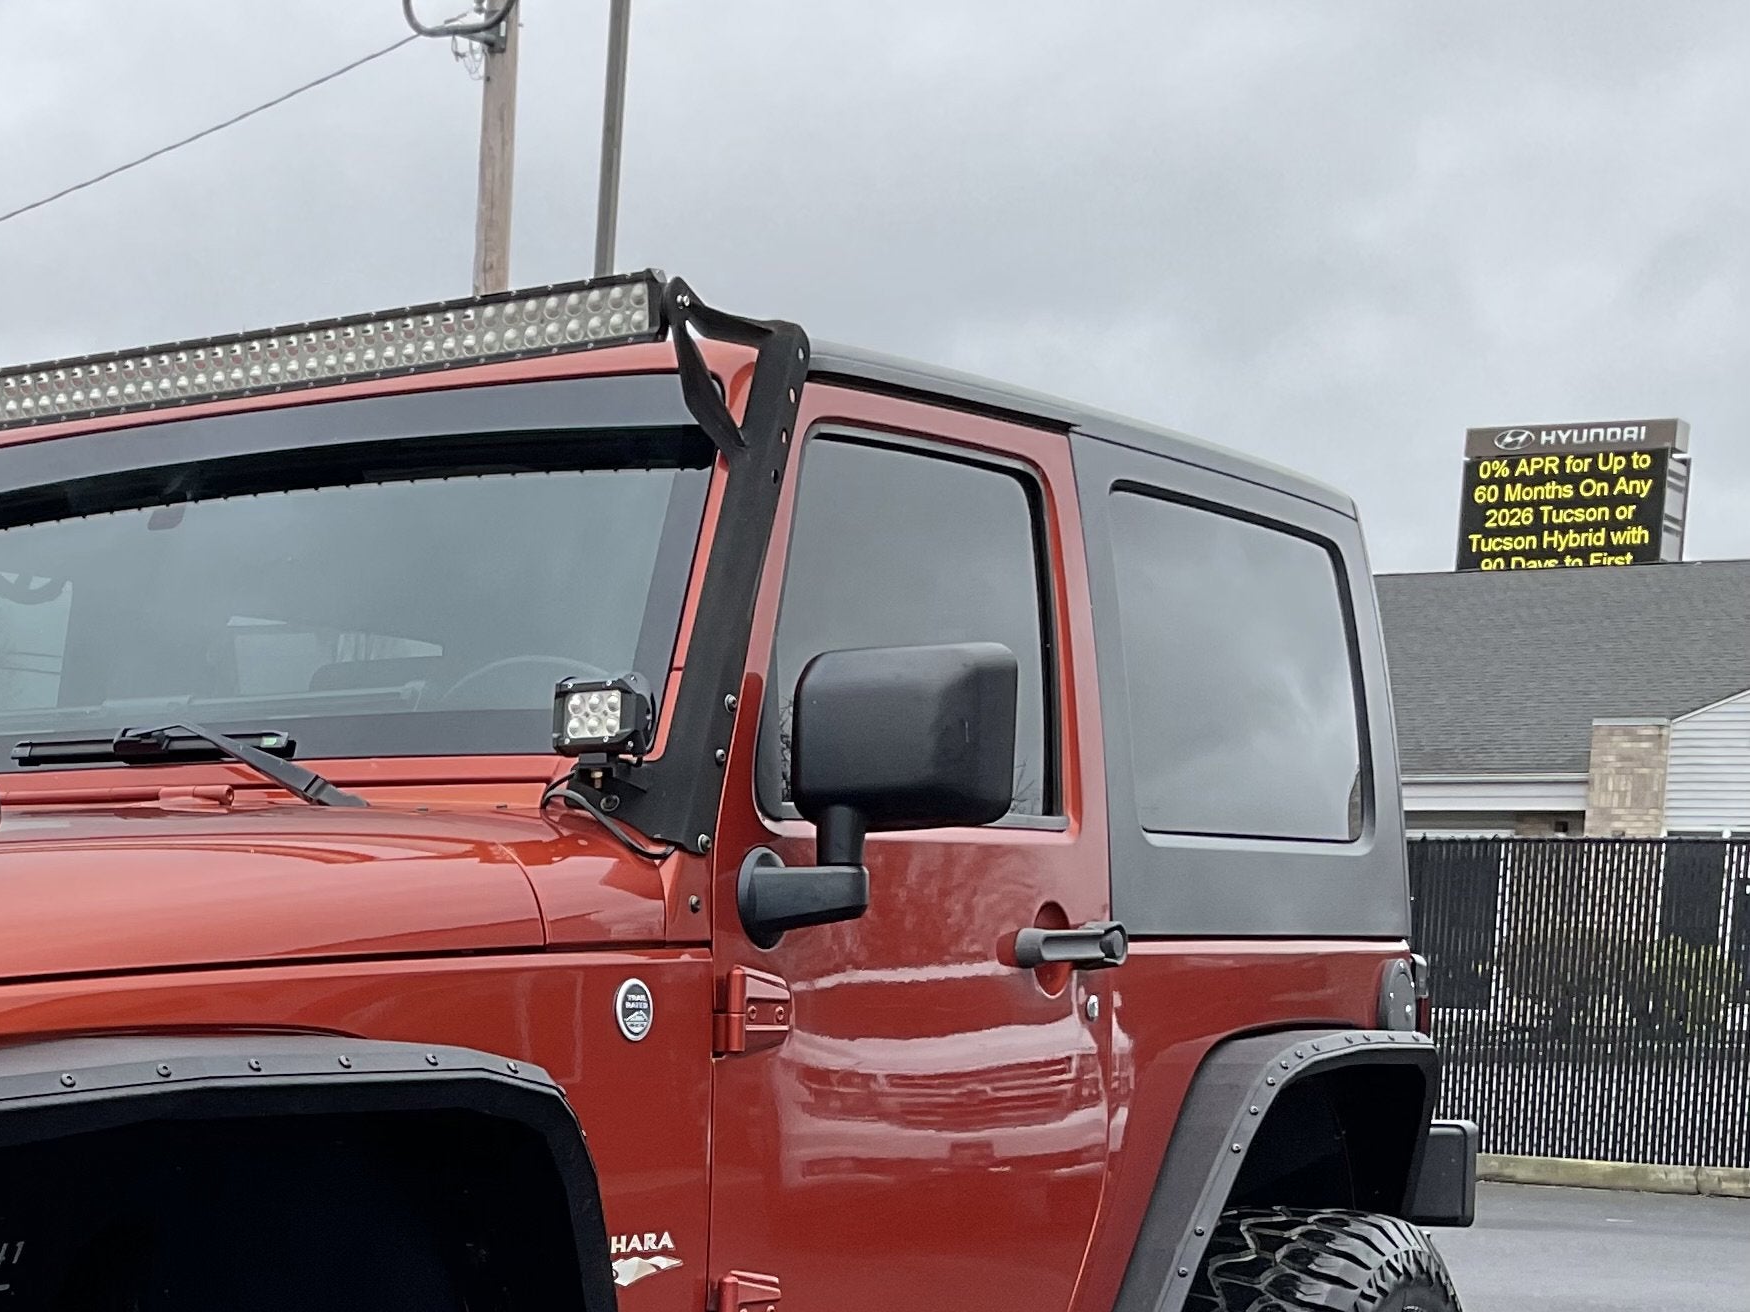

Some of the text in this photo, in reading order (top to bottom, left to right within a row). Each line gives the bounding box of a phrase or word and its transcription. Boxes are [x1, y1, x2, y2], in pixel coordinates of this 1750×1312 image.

[1540, 425, 1646, 446] HYUNDAI
[1479, 451, 1652, 480] 0% APR for Up to
[1474, 476, 1653, 504] 60 Months On Any
[1484, 504, 1637, 529] 2026 Tucson or
[1468, 525, 1650, 553] Tucson Hybrid with
[1589, 551, 1634, 566] First
[610, 1231, 675, 1254] HARA
